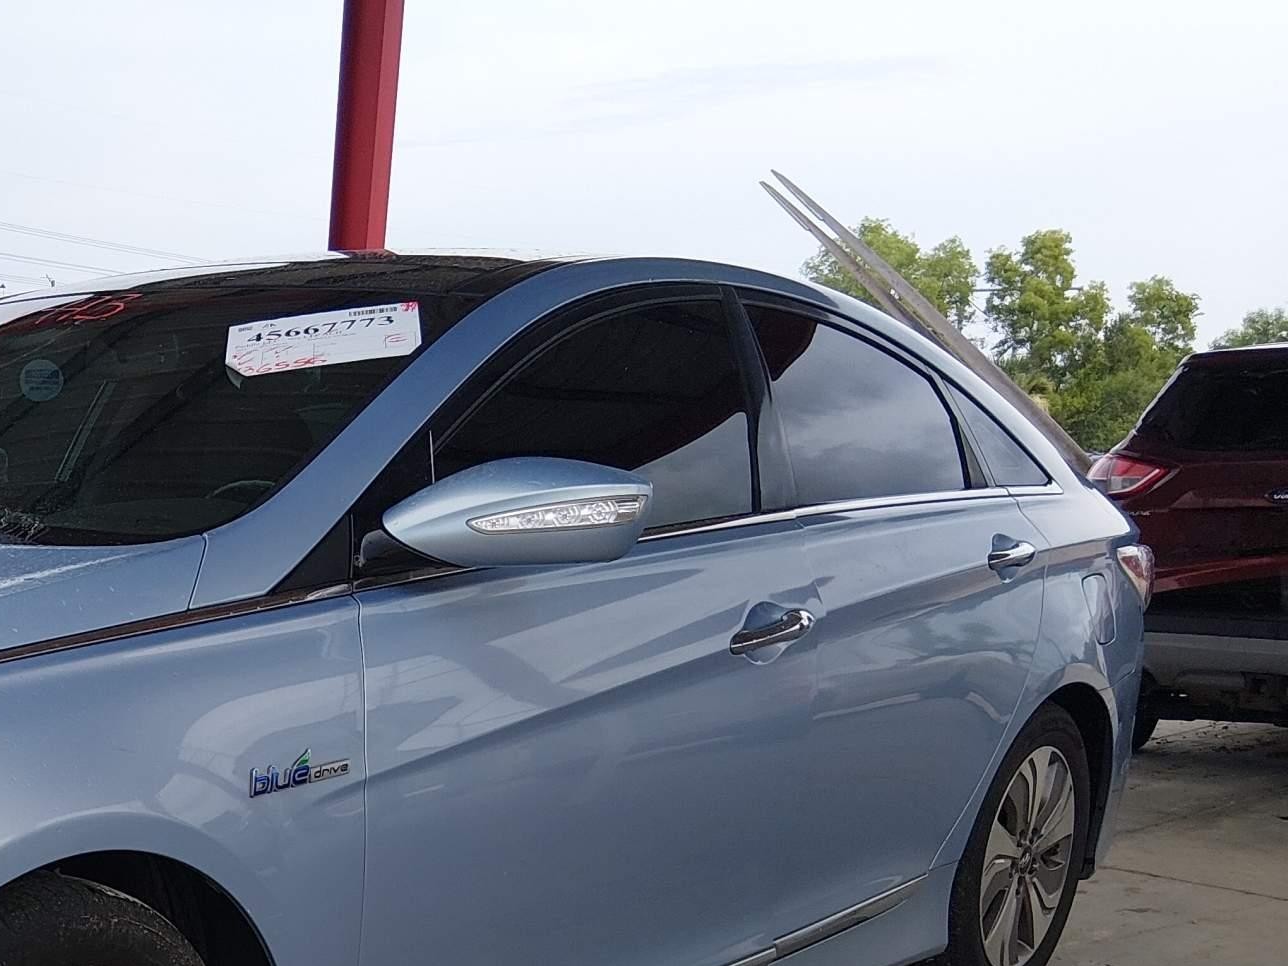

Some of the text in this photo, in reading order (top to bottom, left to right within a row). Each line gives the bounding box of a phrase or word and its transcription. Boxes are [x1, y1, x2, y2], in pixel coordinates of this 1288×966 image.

[247, 316, 394, 343] 45667773
[250, 757, 350, 798] blue drive
